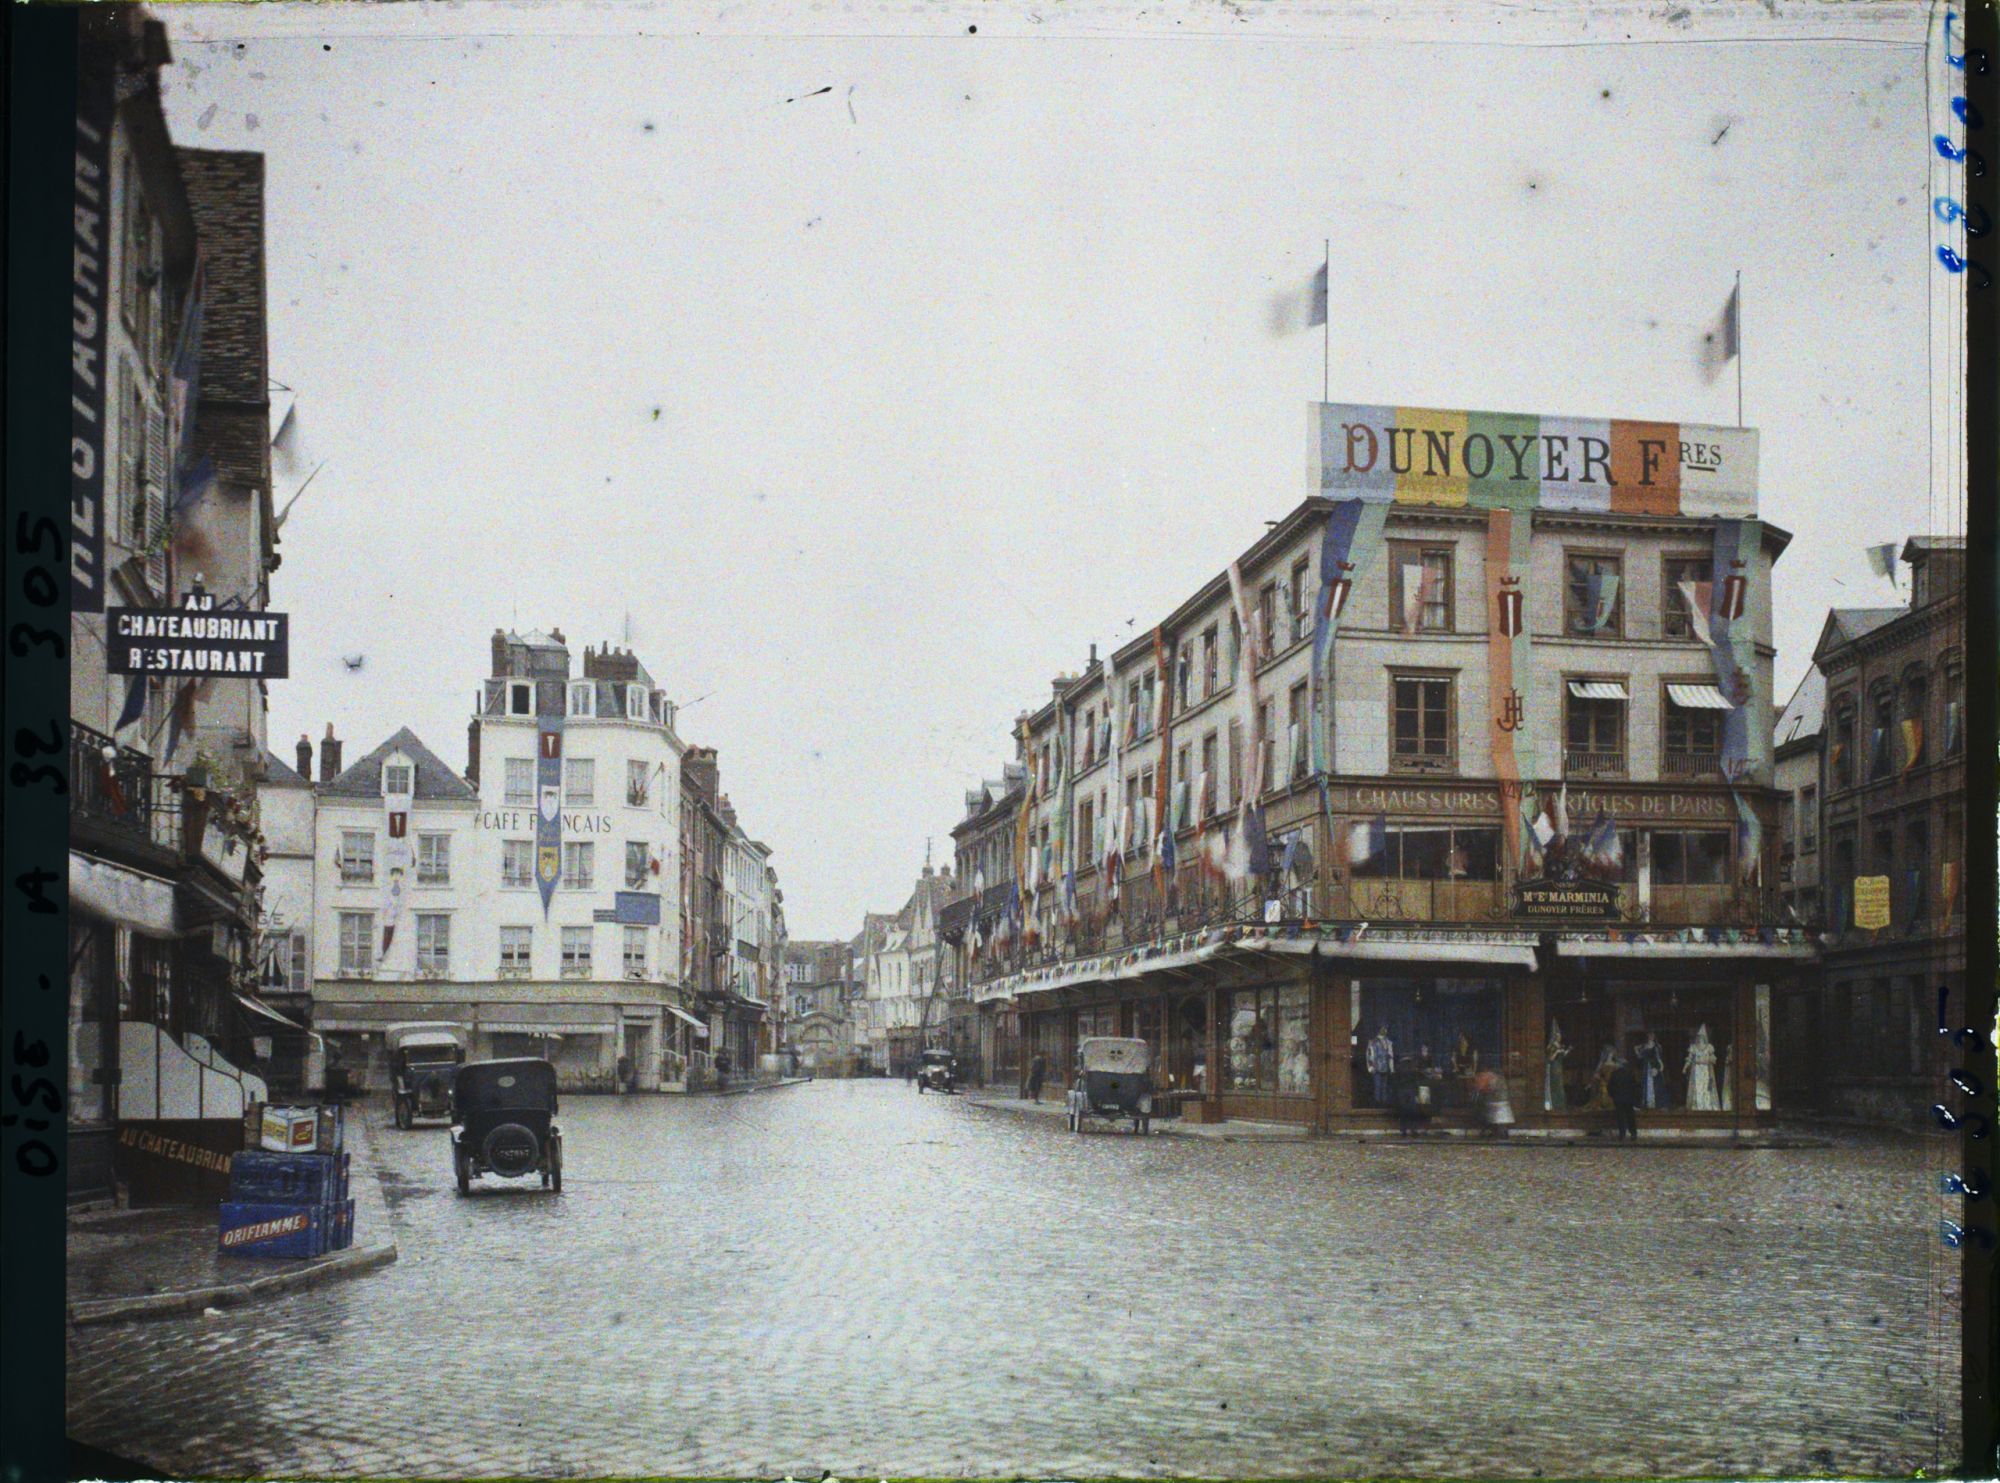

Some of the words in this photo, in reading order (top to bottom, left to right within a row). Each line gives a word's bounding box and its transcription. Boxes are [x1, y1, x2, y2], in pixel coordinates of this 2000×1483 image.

[1341, 422, 1618, 487] DUNOYER
[8, 511, 66, 659] 305
[184, 594, 213, 611] AU
[117, 614, 279, 641] CHATEAUBRIANT
[1355, 787, 1499, 811] CHAUSSURES
[1554, 791, 1635, 812] RTICLES
[1641, 795, 1666, 814] DE
[1669, 793, 1727, 815] PARIS
[528, 812, 612, 834] FNÇAIS
[14, 866, 61, 915] A
[1549, 891, 1609, 904] MARMINIA
[1527, 904, 1567, 914] DUNOYER
[118, 1126, 136, 1147] AU
[223, 1214, 302, 1247] ORIFLAMME
